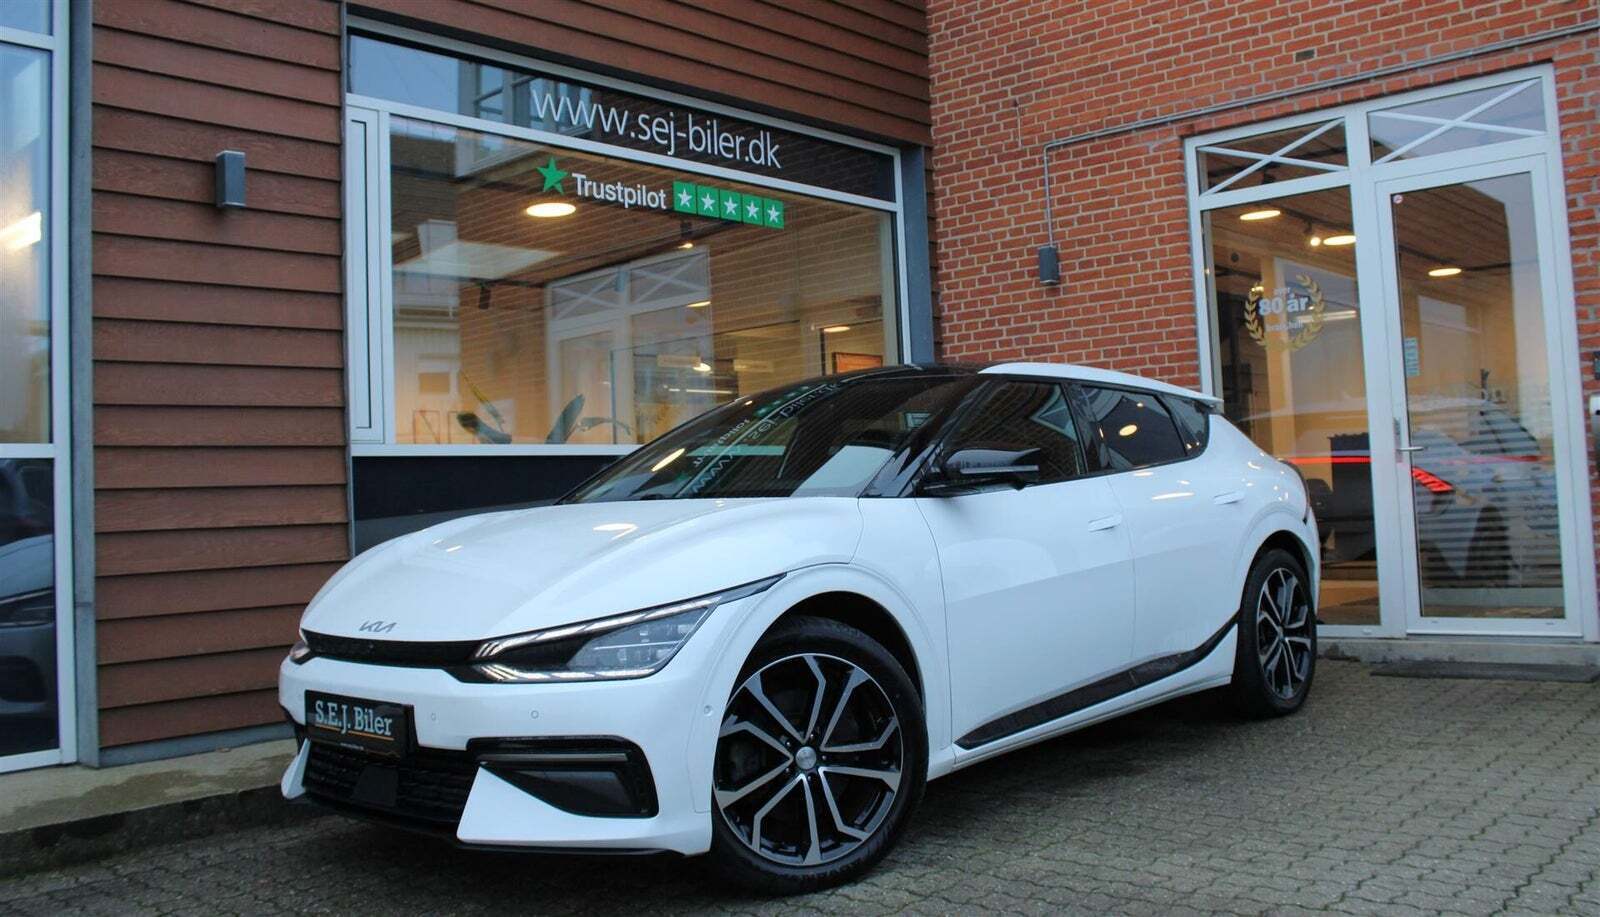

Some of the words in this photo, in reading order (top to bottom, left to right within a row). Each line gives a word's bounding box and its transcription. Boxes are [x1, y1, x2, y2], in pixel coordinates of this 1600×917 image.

[531, 88, 783, 169] www.sej-biler.dk
[571, 172, 667, 209] Trustpilot
[1258, 297, 1284, 316] 80
[1287, 292, 1309, 313] år
[314, 700, 351, 735] S.E.J.
[353, 705, 393, 736] Biler
